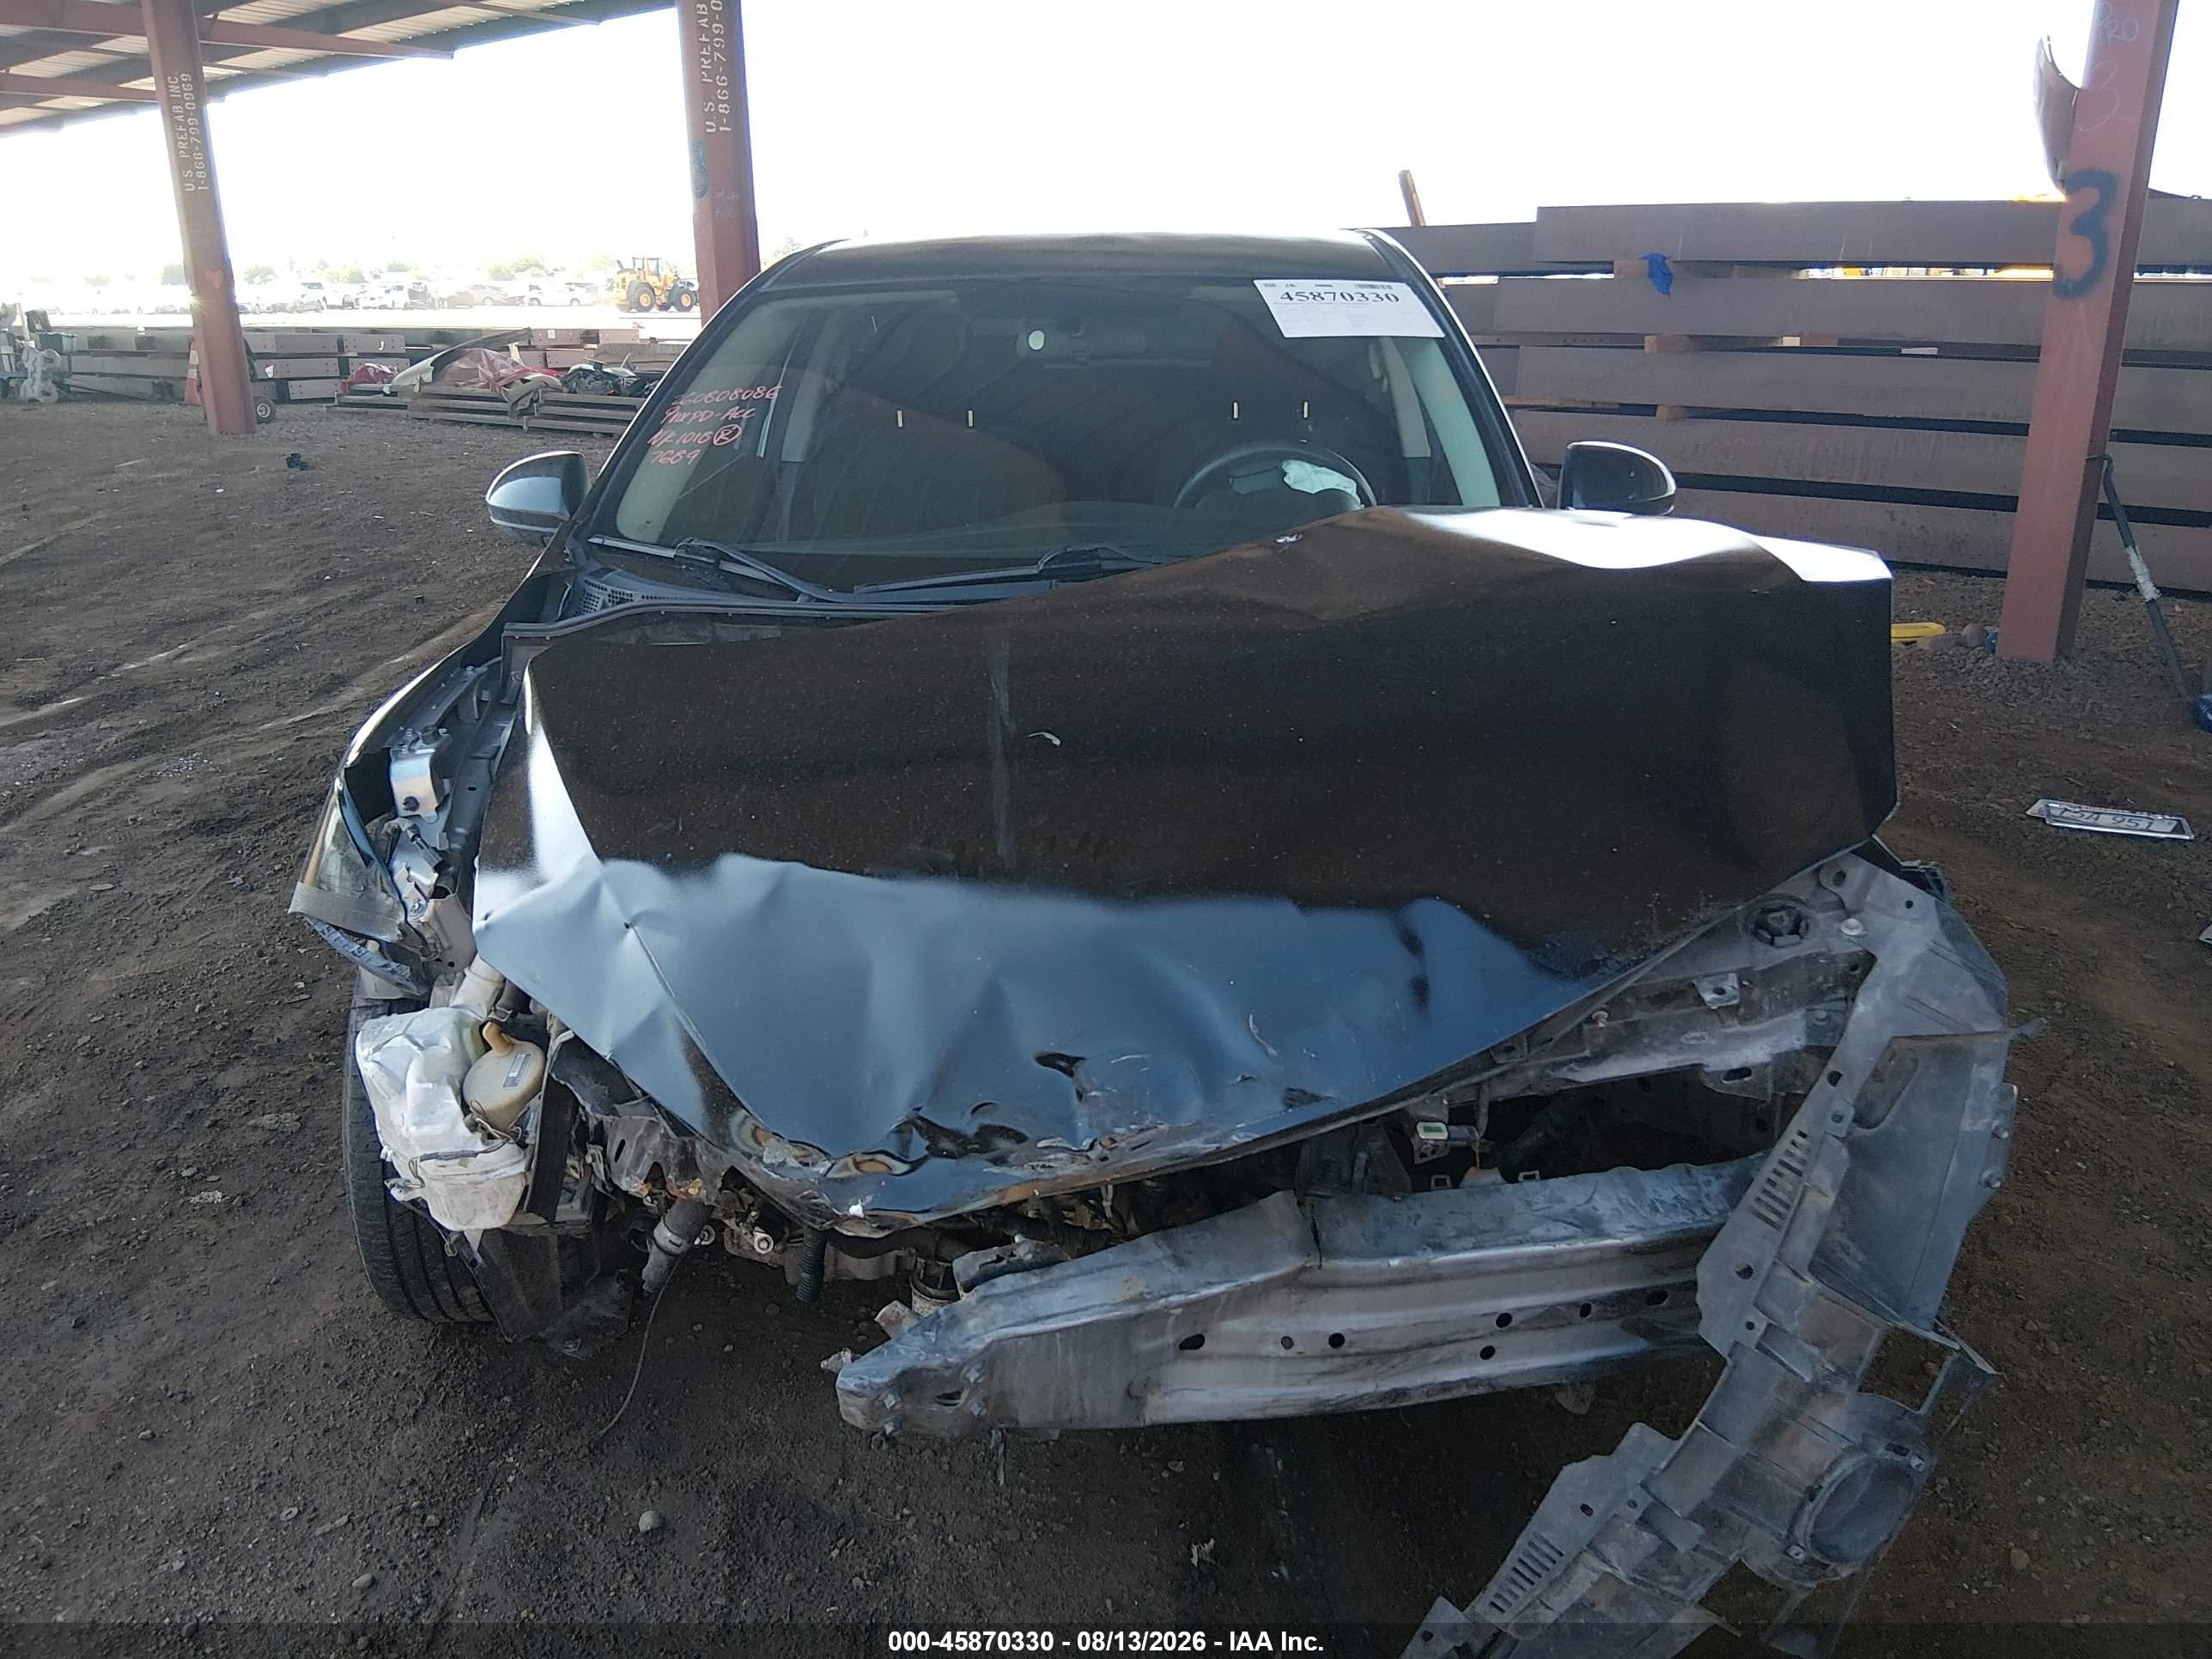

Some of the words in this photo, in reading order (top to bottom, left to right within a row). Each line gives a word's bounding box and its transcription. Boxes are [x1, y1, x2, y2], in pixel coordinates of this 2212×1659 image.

[696, 3, 713, 82] PREFAB
[173, 105, 190, 158] PREFAB
[179, 73, 209, 191] 1-866-799-0969
[2051, 168, 2118, 297] 3
[1279, 290, 1400, 303] 45870330
